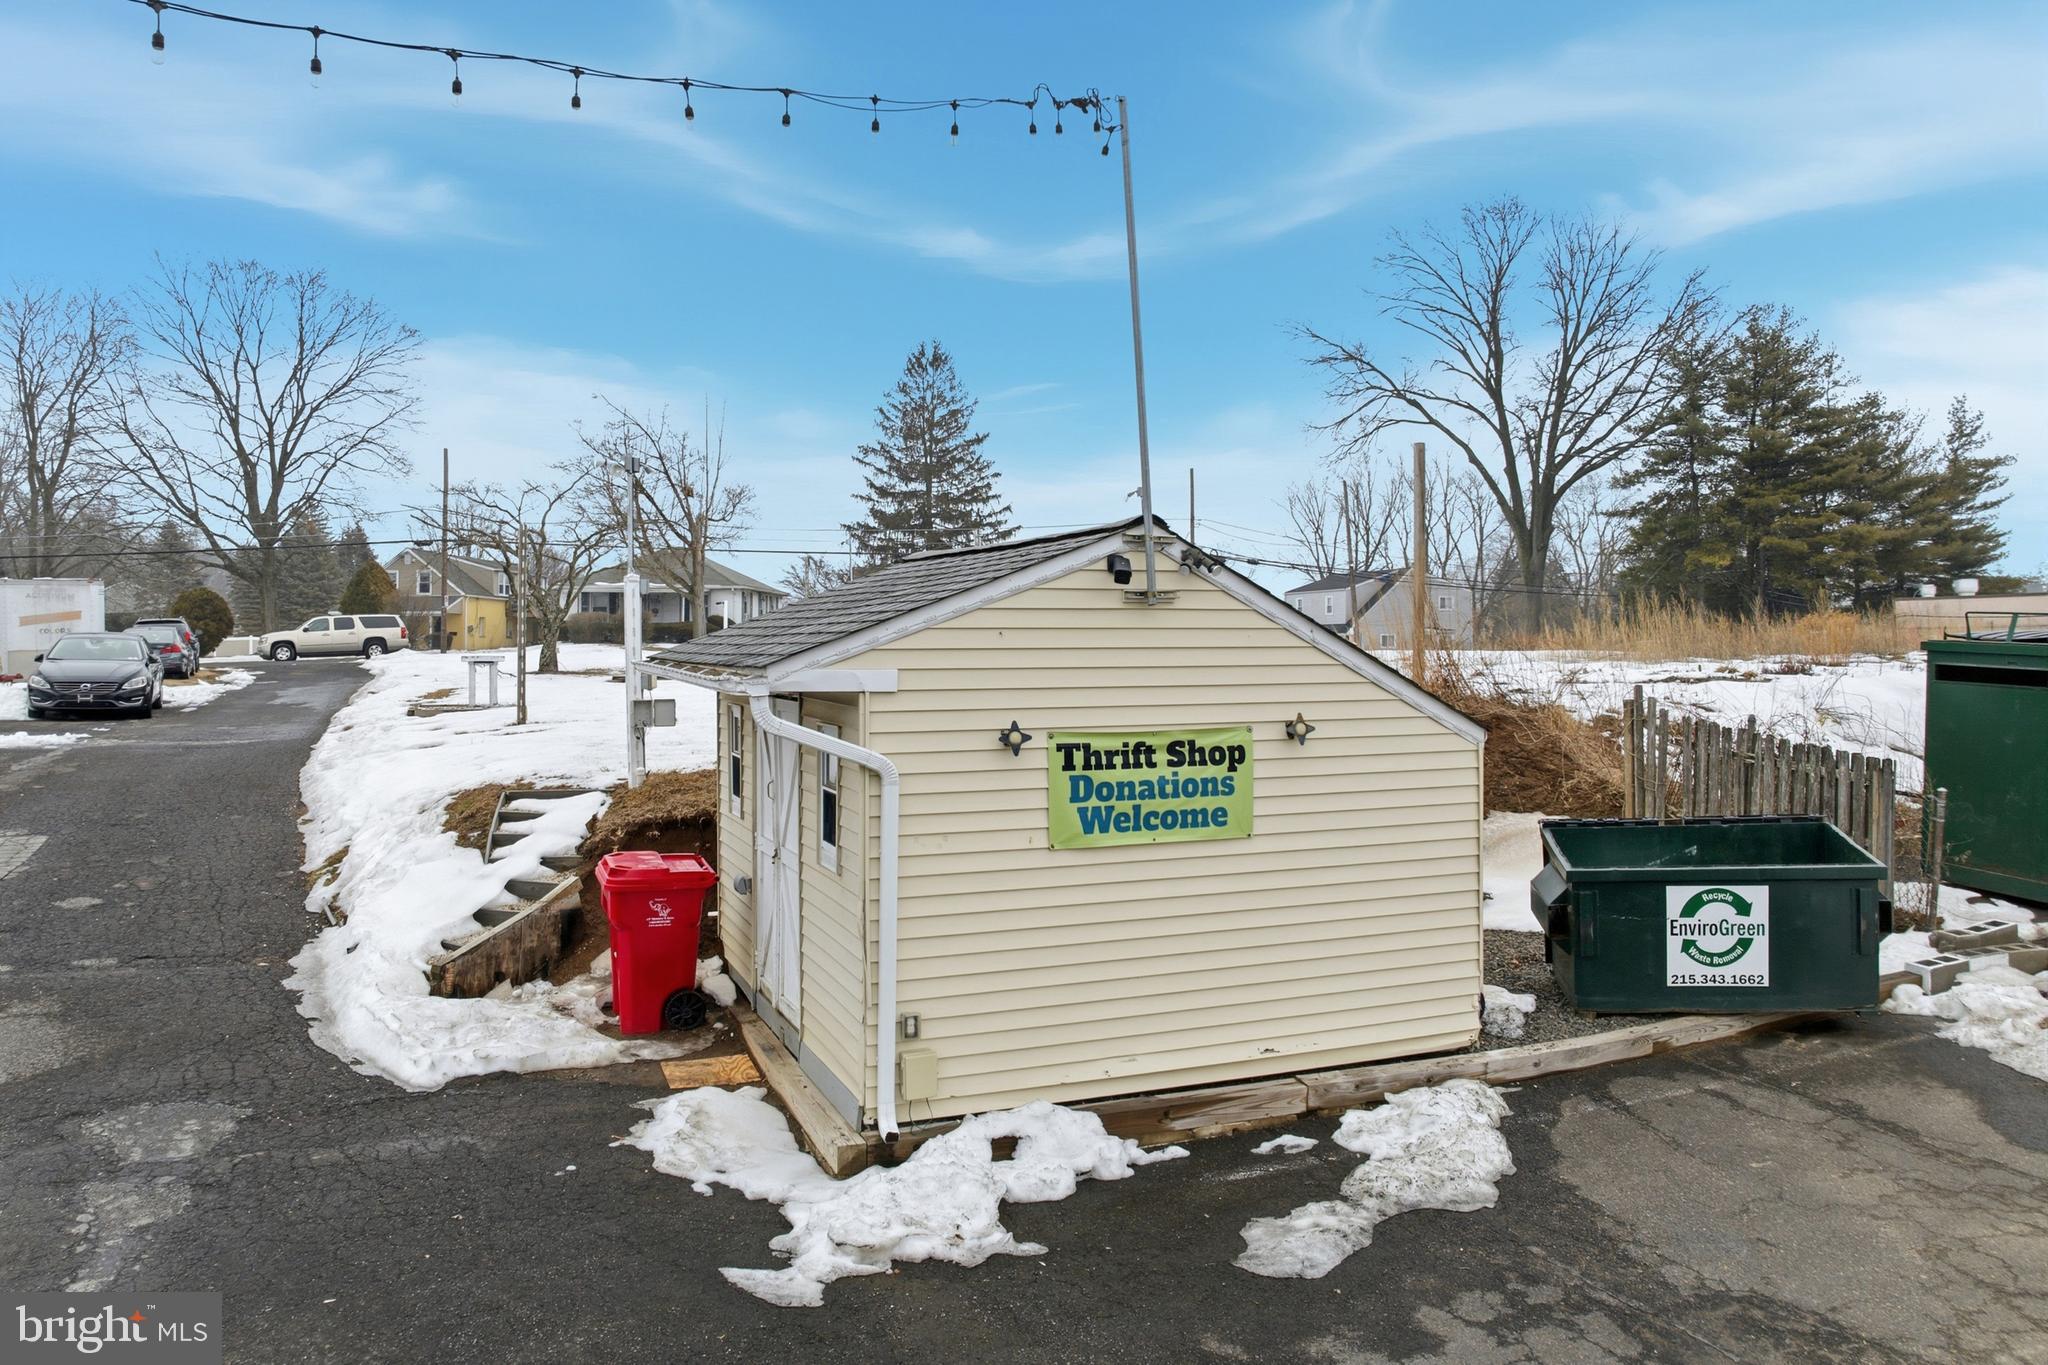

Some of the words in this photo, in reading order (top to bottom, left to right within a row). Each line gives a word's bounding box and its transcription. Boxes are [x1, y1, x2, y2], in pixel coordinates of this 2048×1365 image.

[1056, 742, 1157, 771] Thrift
[1166, 740, 1246, 772] Shop
[1069, 771, 1235, 803] Donations
[1077, 804, 1228, 835] Welcome
[1701, 892, 1733, 902] Recycle
[1670, 919, 1765, 936] EnviroGreen
[1688, 946, 1711, 964] Waste
[1713, 945, 1744, 964] Removal
[1671, 974, 1765, 984] 215.343.1662
